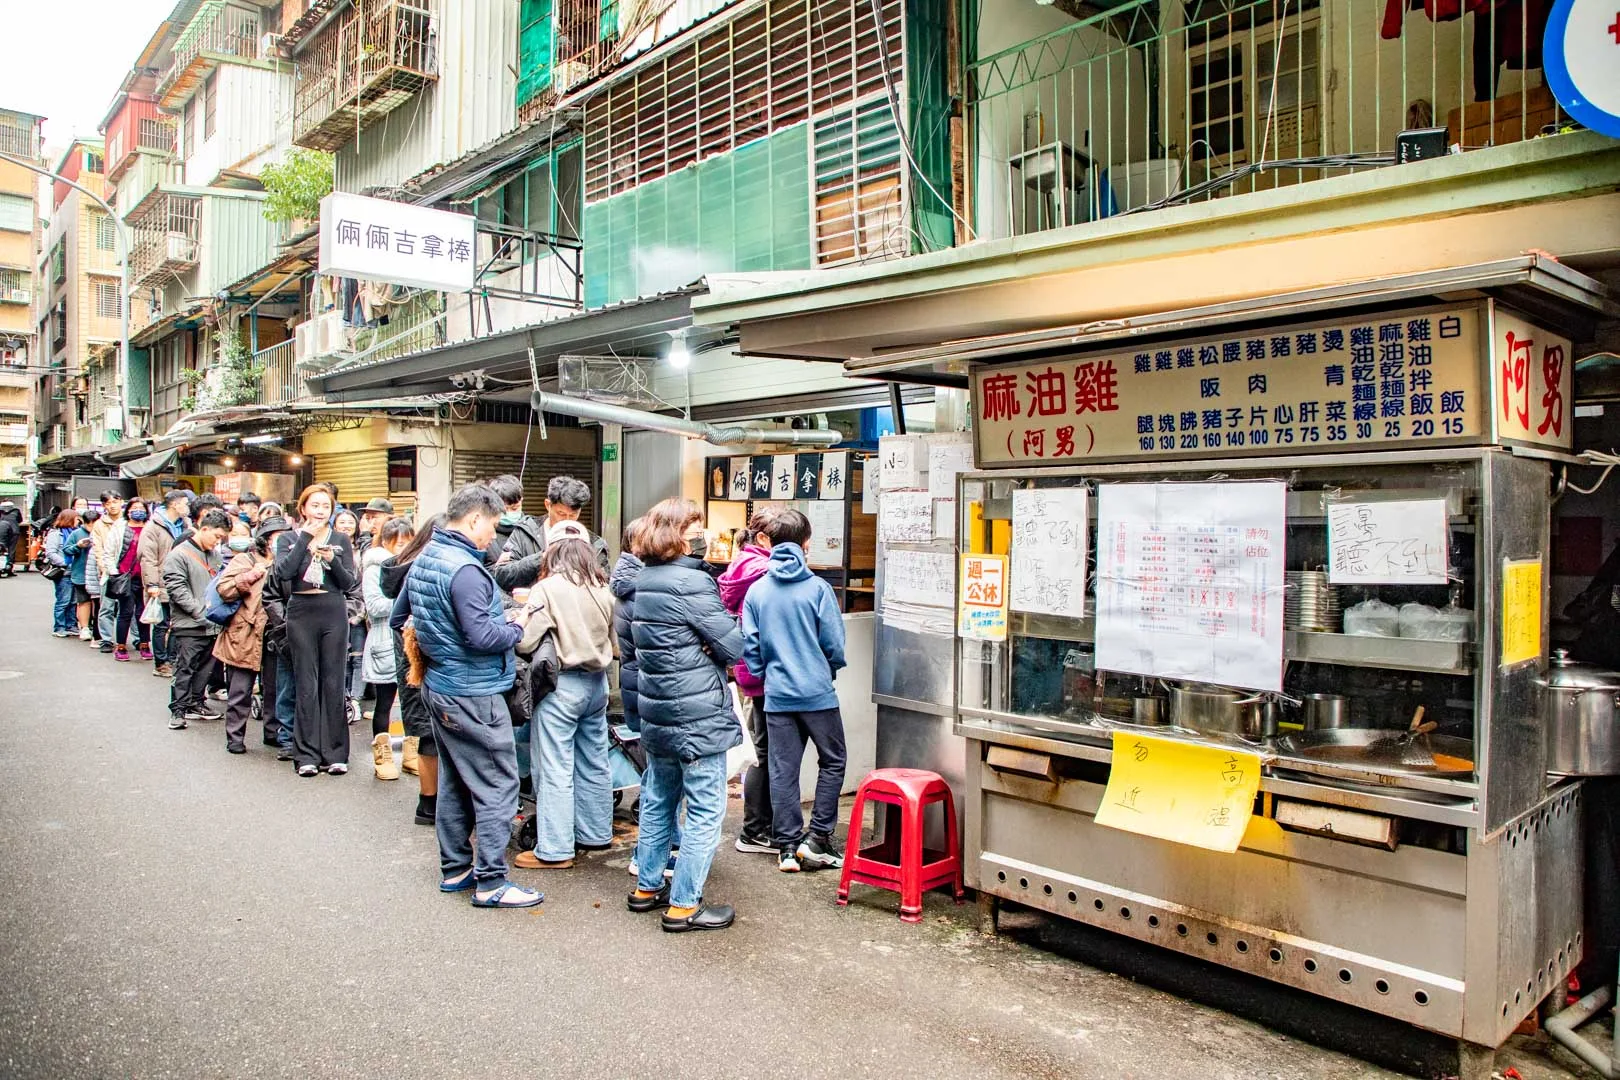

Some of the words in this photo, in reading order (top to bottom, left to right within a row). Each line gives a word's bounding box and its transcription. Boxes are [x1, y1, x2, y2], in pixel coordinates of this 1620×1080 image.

[336, 218, 471, 263] 倆倆吉拿棒
[1407, 319, 1434, 415] 雞油拌飯
[1439, 315, 1465, 413] 白飯
[1246, 339, 1269, 426] 豬肉片
[1270, 336, 1294, 425] 豬心
[1295, 332, 1319, 423] 豬肝
[1322, 329, 1347, 423] 燙青菜
[1502, 330, 1564, 438] 阿男
[982, 359, 1120, 422] 麻油雞
[1300, 425, 1320, 442] 75
[1327, 424, 1347, 441] 35
[1356, 422, 1372, 439] 30
[1384, 421, 1401, 438] 25
[1412, 419, 1435, 437] 20
[1442, 417, 1464, 435] 15
[1138, 436, 1155, 451] 160
[1158, 435, 1175, 450] 130
[1180, 434, 1199, 449] 220
[1204, 431, 1221, 448] 160
[1226, 430, 1245, 447] 140
[1250, 429, 1269, 446] 100
[1275, 428, 1294, 444] 75
[732, 466, 843, 493] 倆倆吉拿棒
[1245, 527, 1270, 541] 請勿
[1244, 545, 1270, 559] 佔位
[968, 560, 999, 579] 週一
[967, 582, 998, 602] 公休
[1207, 755, 1244, 827] 高溫
